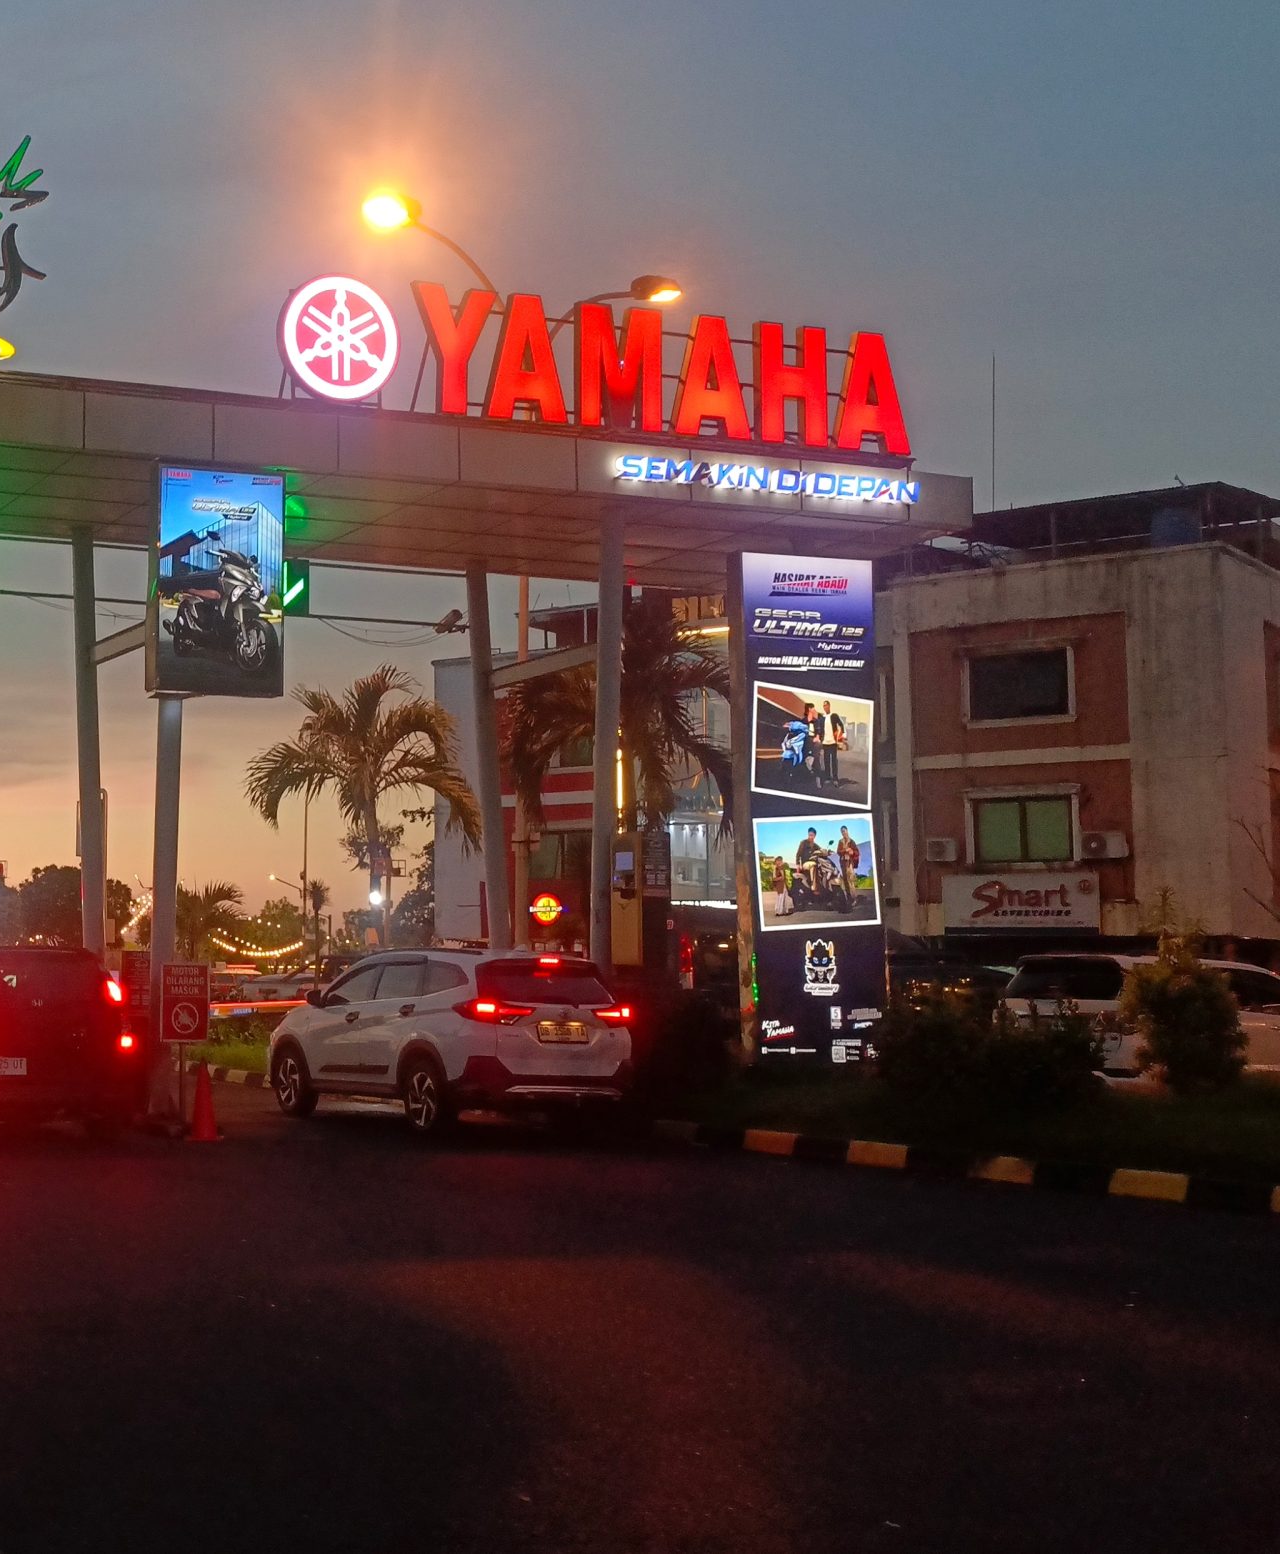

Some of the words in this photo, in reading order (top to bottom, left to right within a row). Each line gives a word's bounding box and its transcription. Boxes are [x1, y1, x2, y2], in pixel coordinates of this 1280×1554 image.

[410, 280, 913, 457] YAMAHA
[811, 472, 921, 503] DEPAN
[754, 608, 821, 619] GEAR
[753, 619, 837, 637] ULTIMA
[841, 626, 864, 636] 125
[817, 642, 853, 651] Hybrid
[758, 656, 781, 664] MOTOR
[781, 656, 809, 666] HEBAT,
[810, 657, 833, 667] KUAT,
[844, 660, 865, 668] DEBAT
[971, 880, 1071, 918] Smart
[171, 967, 199, 975] MOTOR
[166, 976, 204, 985] DILARANG
[171, 986, 200, 995] MASUK
[766, 1025, 795, 1038] YAMAHA
